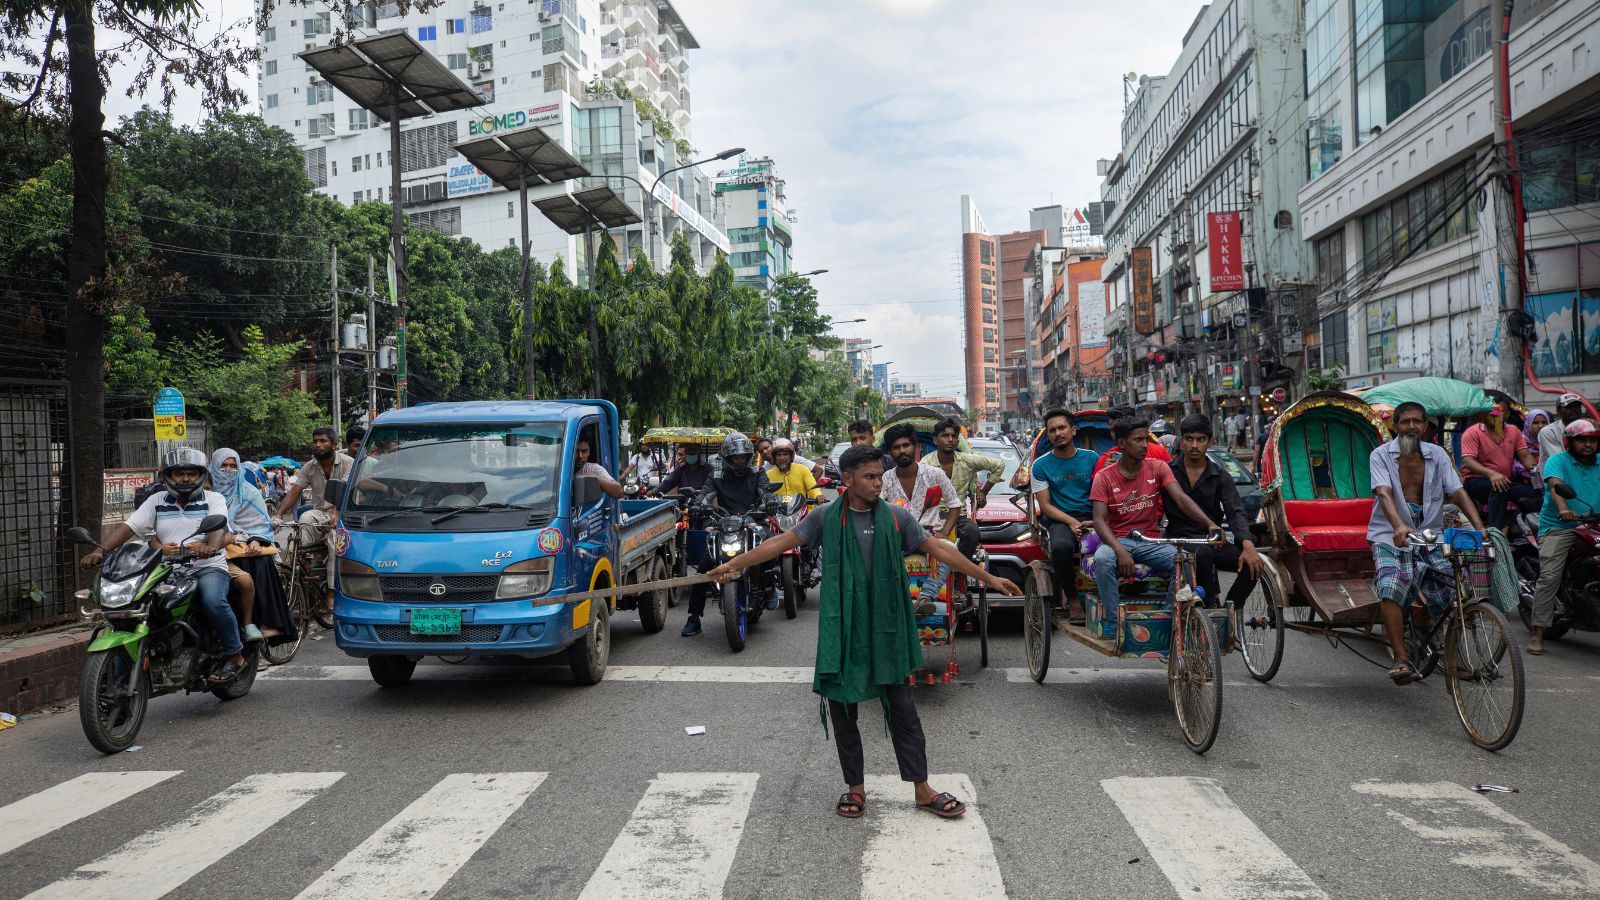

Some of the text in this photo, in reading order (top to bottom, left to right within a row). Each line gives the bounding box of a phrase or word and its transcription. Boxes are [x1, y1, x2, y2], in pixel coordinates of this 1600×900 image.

[1220, 224, 1230, 275] HAKKA
[376, 560, 399, 568] TATA
[481, 559, 501, 567] ACE
